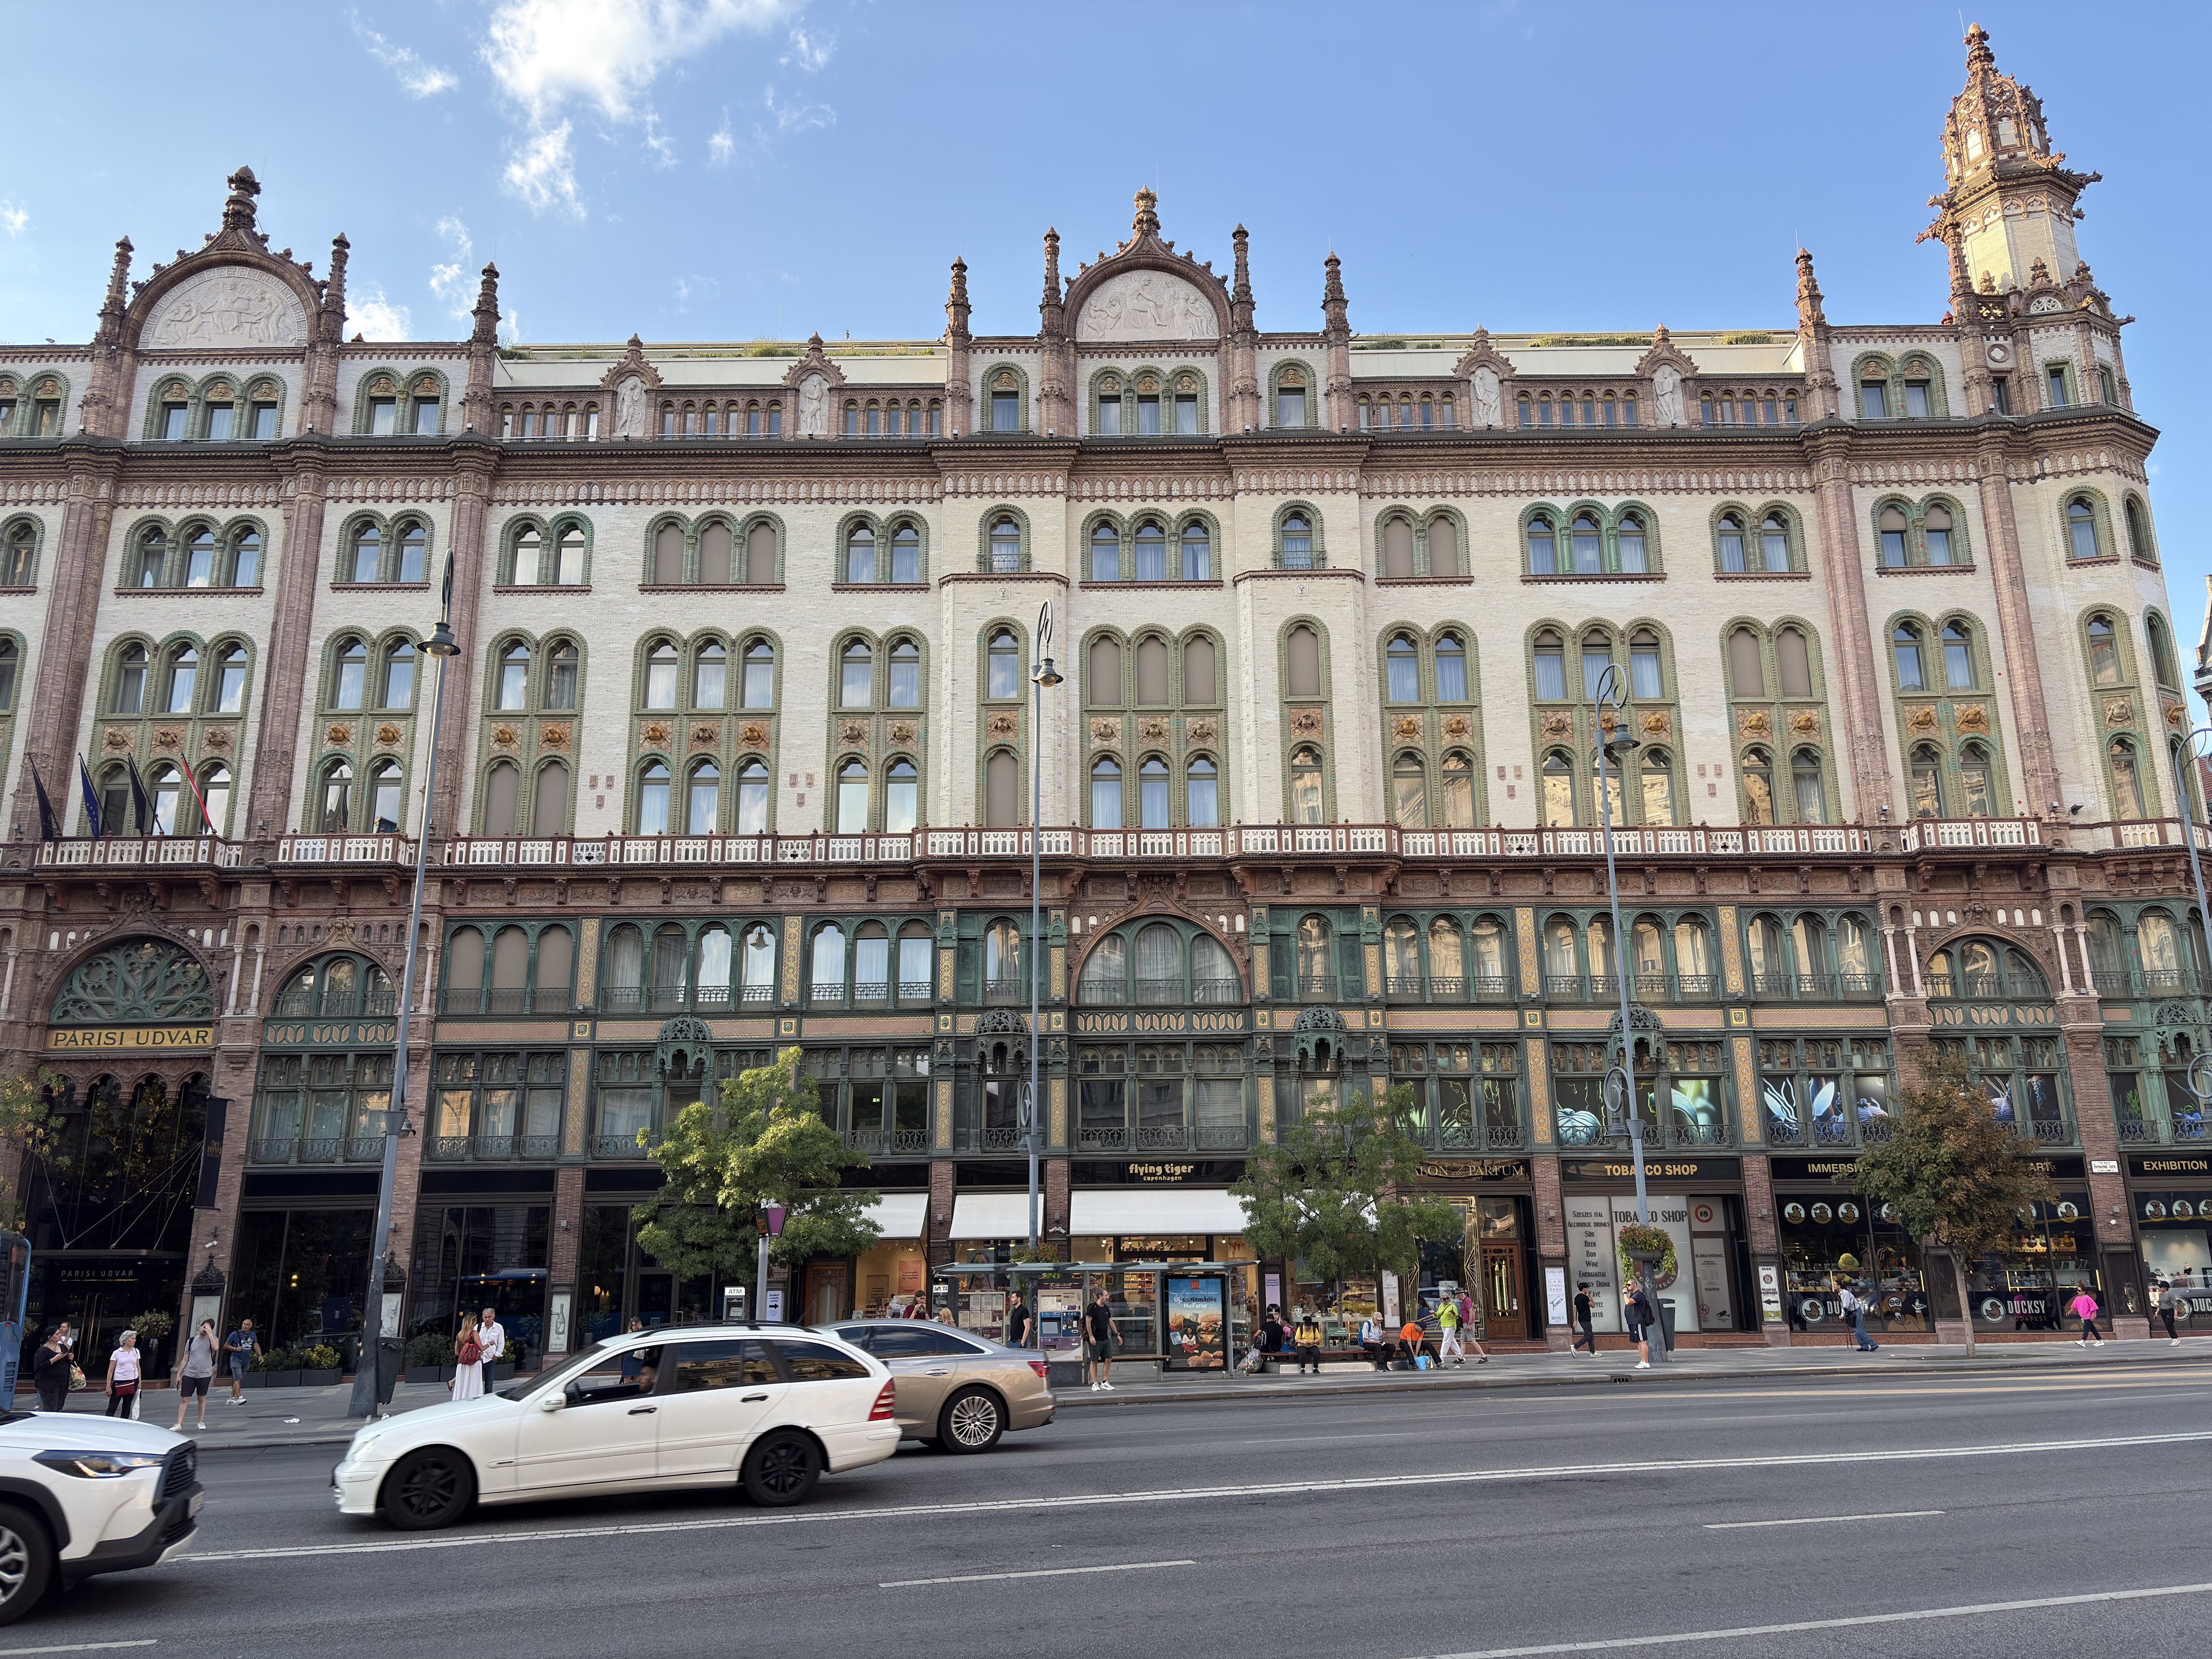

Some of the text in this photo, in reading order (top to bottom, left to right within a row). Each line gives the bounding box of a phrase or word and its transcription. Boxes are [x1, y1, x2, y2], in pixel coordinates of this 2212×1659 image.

[54, 1030, 209, 1046] PÁRISI UDVAR
[1129, 1163, 1194, 1176] flying tiger
[1468, 1165, 1524, 1176] PARFUM
[1604, 1164, 1698, 1176] TOBACO SHOP
[2143, 1160, 2208, 1171] EXHIBITION
[1613, 1210, 1688, 1223] TOBAO SHOP
[2007, 1300, 2046, 1314] DUCKSY
